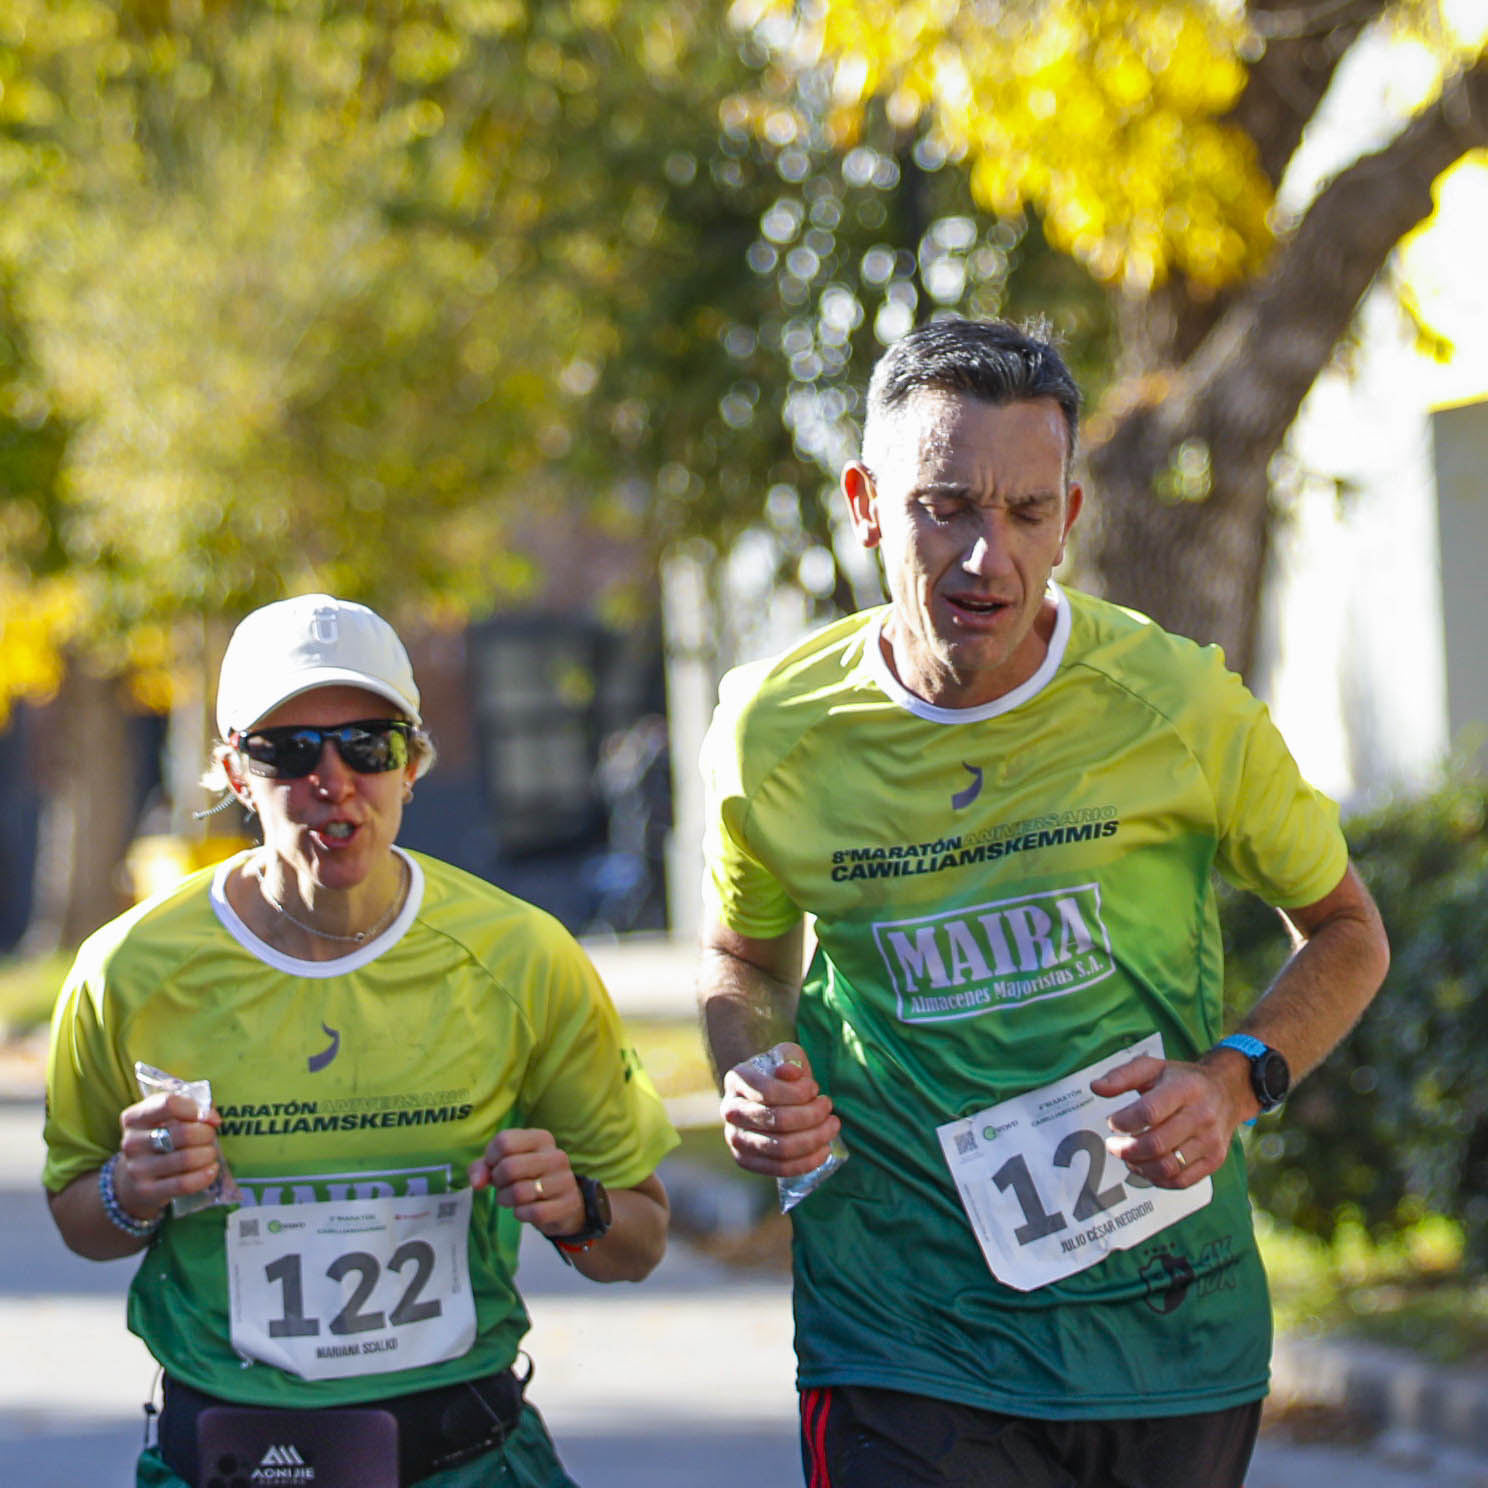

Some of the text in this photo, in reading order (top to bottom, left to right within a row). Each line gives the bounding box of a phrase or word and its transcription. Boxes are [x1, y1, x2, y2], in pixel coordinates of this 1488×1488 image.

[831, 820, 1120, 882] CAWILLIAMSKEMMIS
[887, 897, 1096, 992] MAIRA
[911, 985, 991, 1015] Almacenes
[993, 969, 1075, 1001] Mayoristas
[991, 1129, 1155, 1247] 12
[1060, 1233, 1087, 1254] JULIO
[264, 1239, 443, 1339] 122
